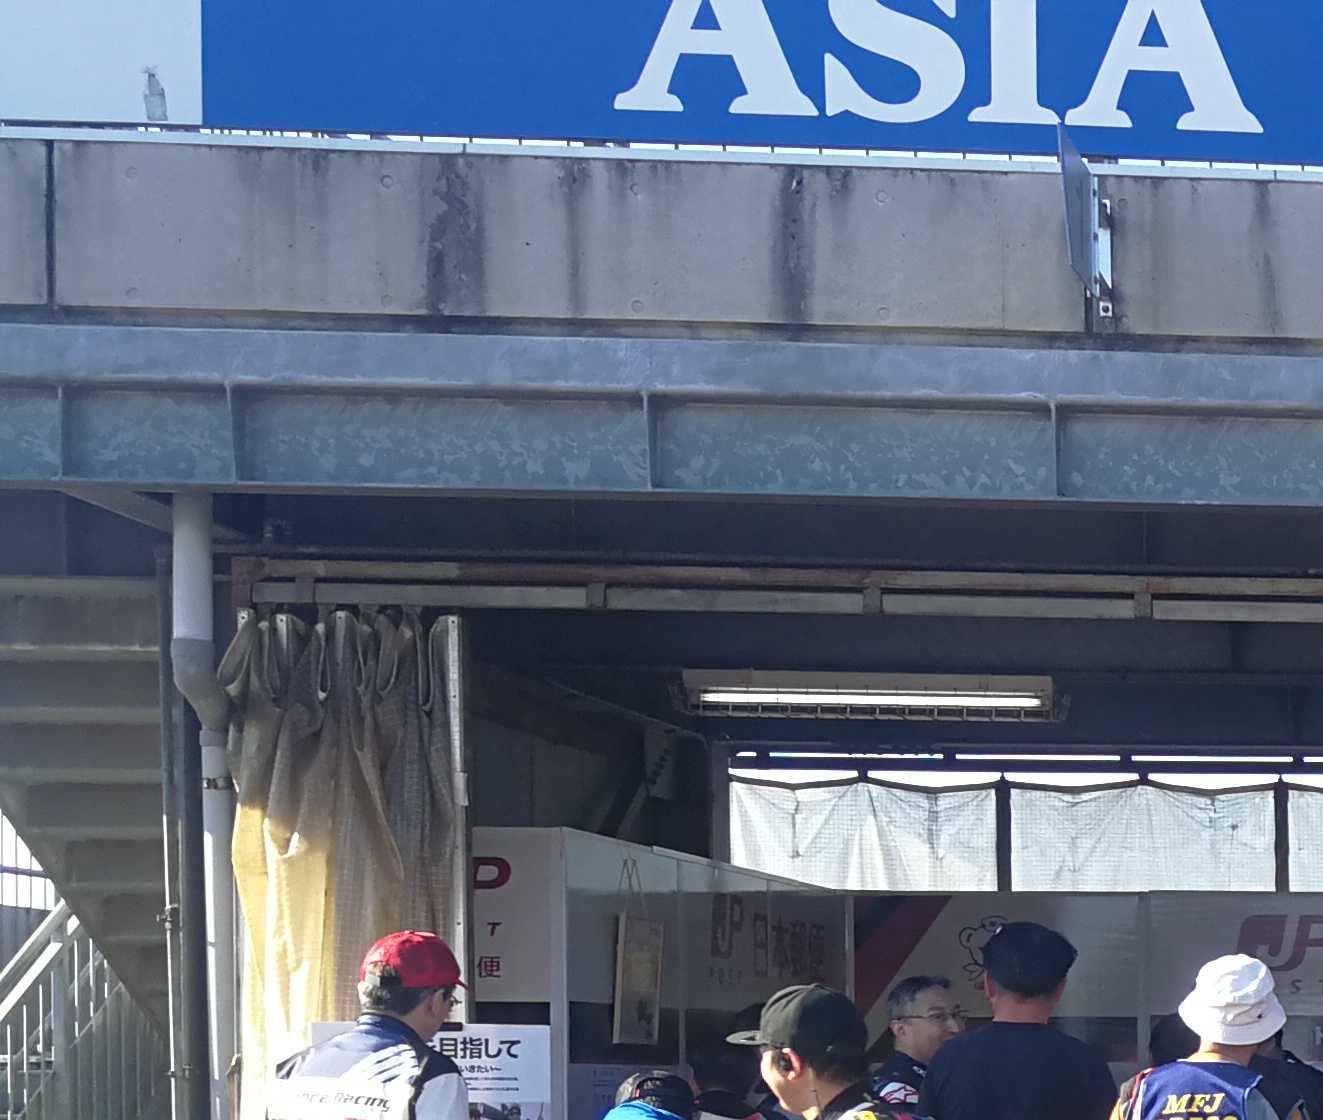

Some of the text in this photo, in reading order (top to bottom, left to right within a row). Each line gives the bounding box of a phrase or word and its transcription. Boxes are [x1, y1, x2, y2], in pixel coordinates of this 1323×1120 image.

[614, 0, 1261, 125] ASIA
[426, 1036, 521, 1059] 目指して
[1162, 1093, 1226, 1115] MFJ
